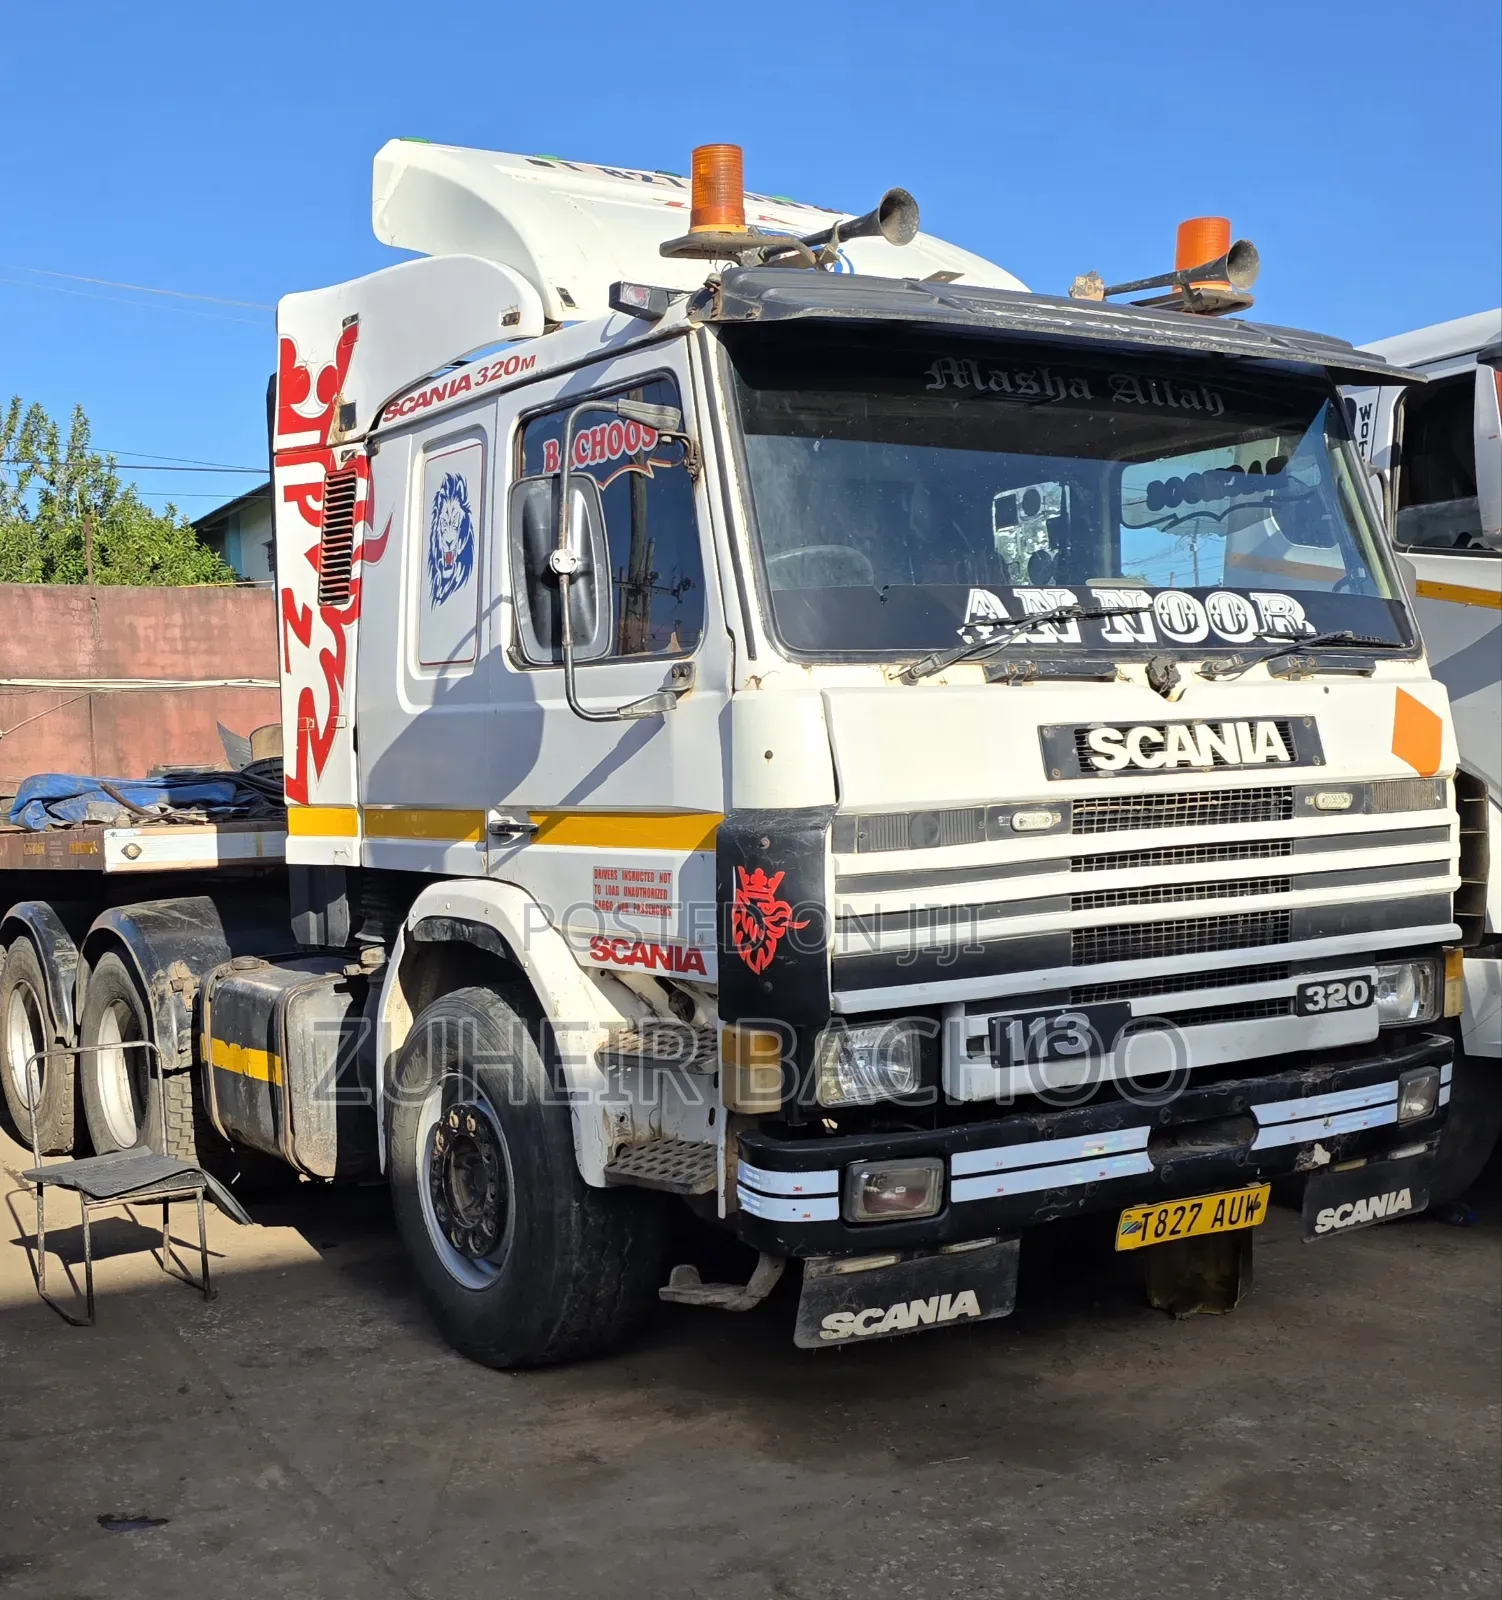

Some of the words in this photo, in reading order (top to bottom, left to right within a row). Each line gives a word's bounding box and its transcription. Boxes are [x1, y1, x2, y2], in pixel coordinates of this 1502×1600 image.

[382, 373, 472, 422] SCANIA
[924, 356, 1096, 403] Masha
[1107, 373, 1226, 418] Allah
[542, 418, 659, 475] BCHOOS
[1358, 402, 1373, 463] WOT
[956, 587, 1084, 645] AN
[1091, 588, 1318, 645] NOOR
[1087, 720, 1292, 772] SCANIA
[594, 868, 618, 881] DRIVERS
[658, 872, 672, 884] NOT
[594, 884, 602, 896] TO
[605, 885, 620, 897] LOAD
[623, 886, 668, 900] UNAUTHORIZED
[633, 902, 672, 917] PASSENGERS
[589, 935, 708, 976] SCANIA
[1304, 980, 1369, 1012] 320
[1005, 1012, 1092, 1061] 113
[1314, 1187, 1412, 1234] SCANIA
[819, 1289, 981, 1340] SCANIA
